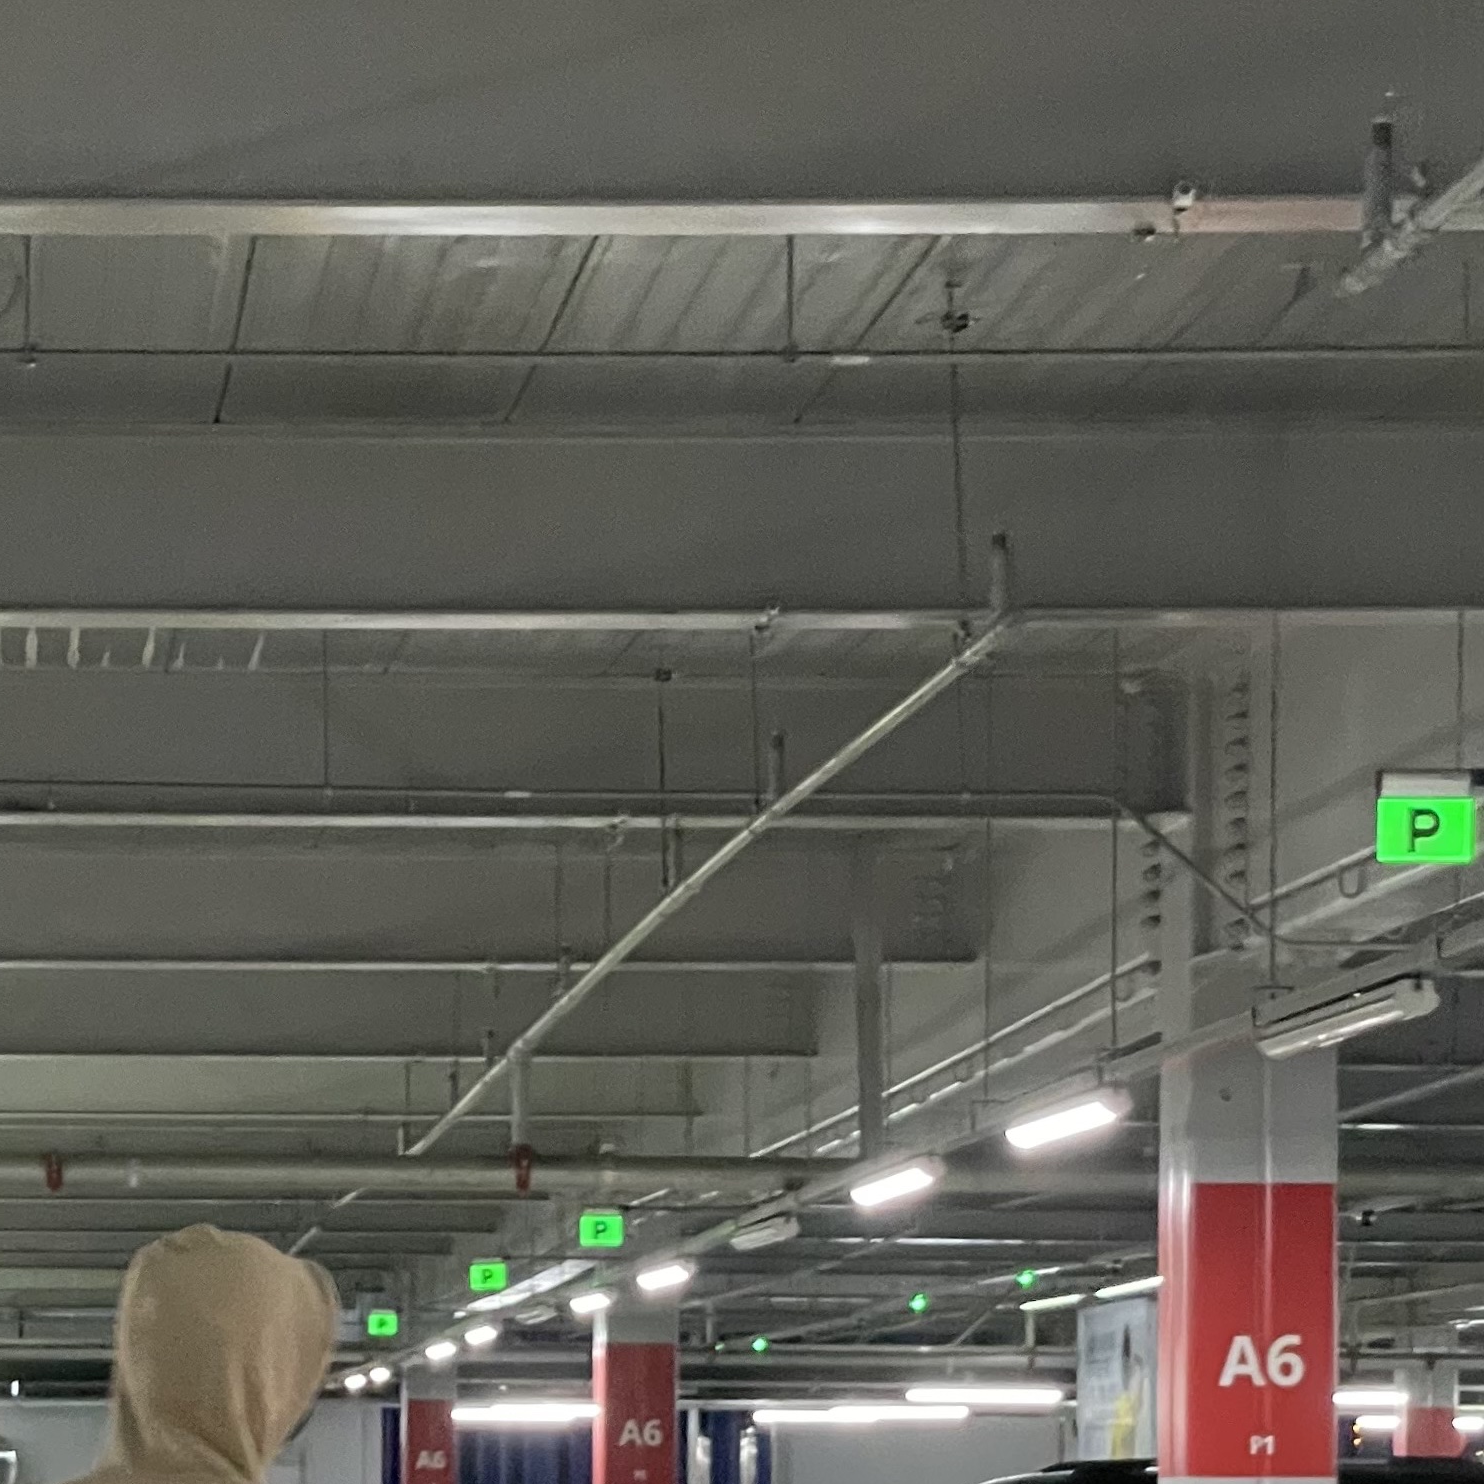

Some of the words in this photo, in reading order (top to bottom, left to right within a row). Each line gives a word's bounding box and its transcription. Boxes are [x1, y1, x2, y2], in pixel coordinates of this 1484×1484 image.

[1407, 807, 1440, 853] P
[593, 1220, 607, 1240] P
[482, 1268, 493, 1284] P
[1218, 1334, 1306, 1388] A6
[619, 1419, 663, 1446] A6
[415, 1450, 446, 1470] A6
